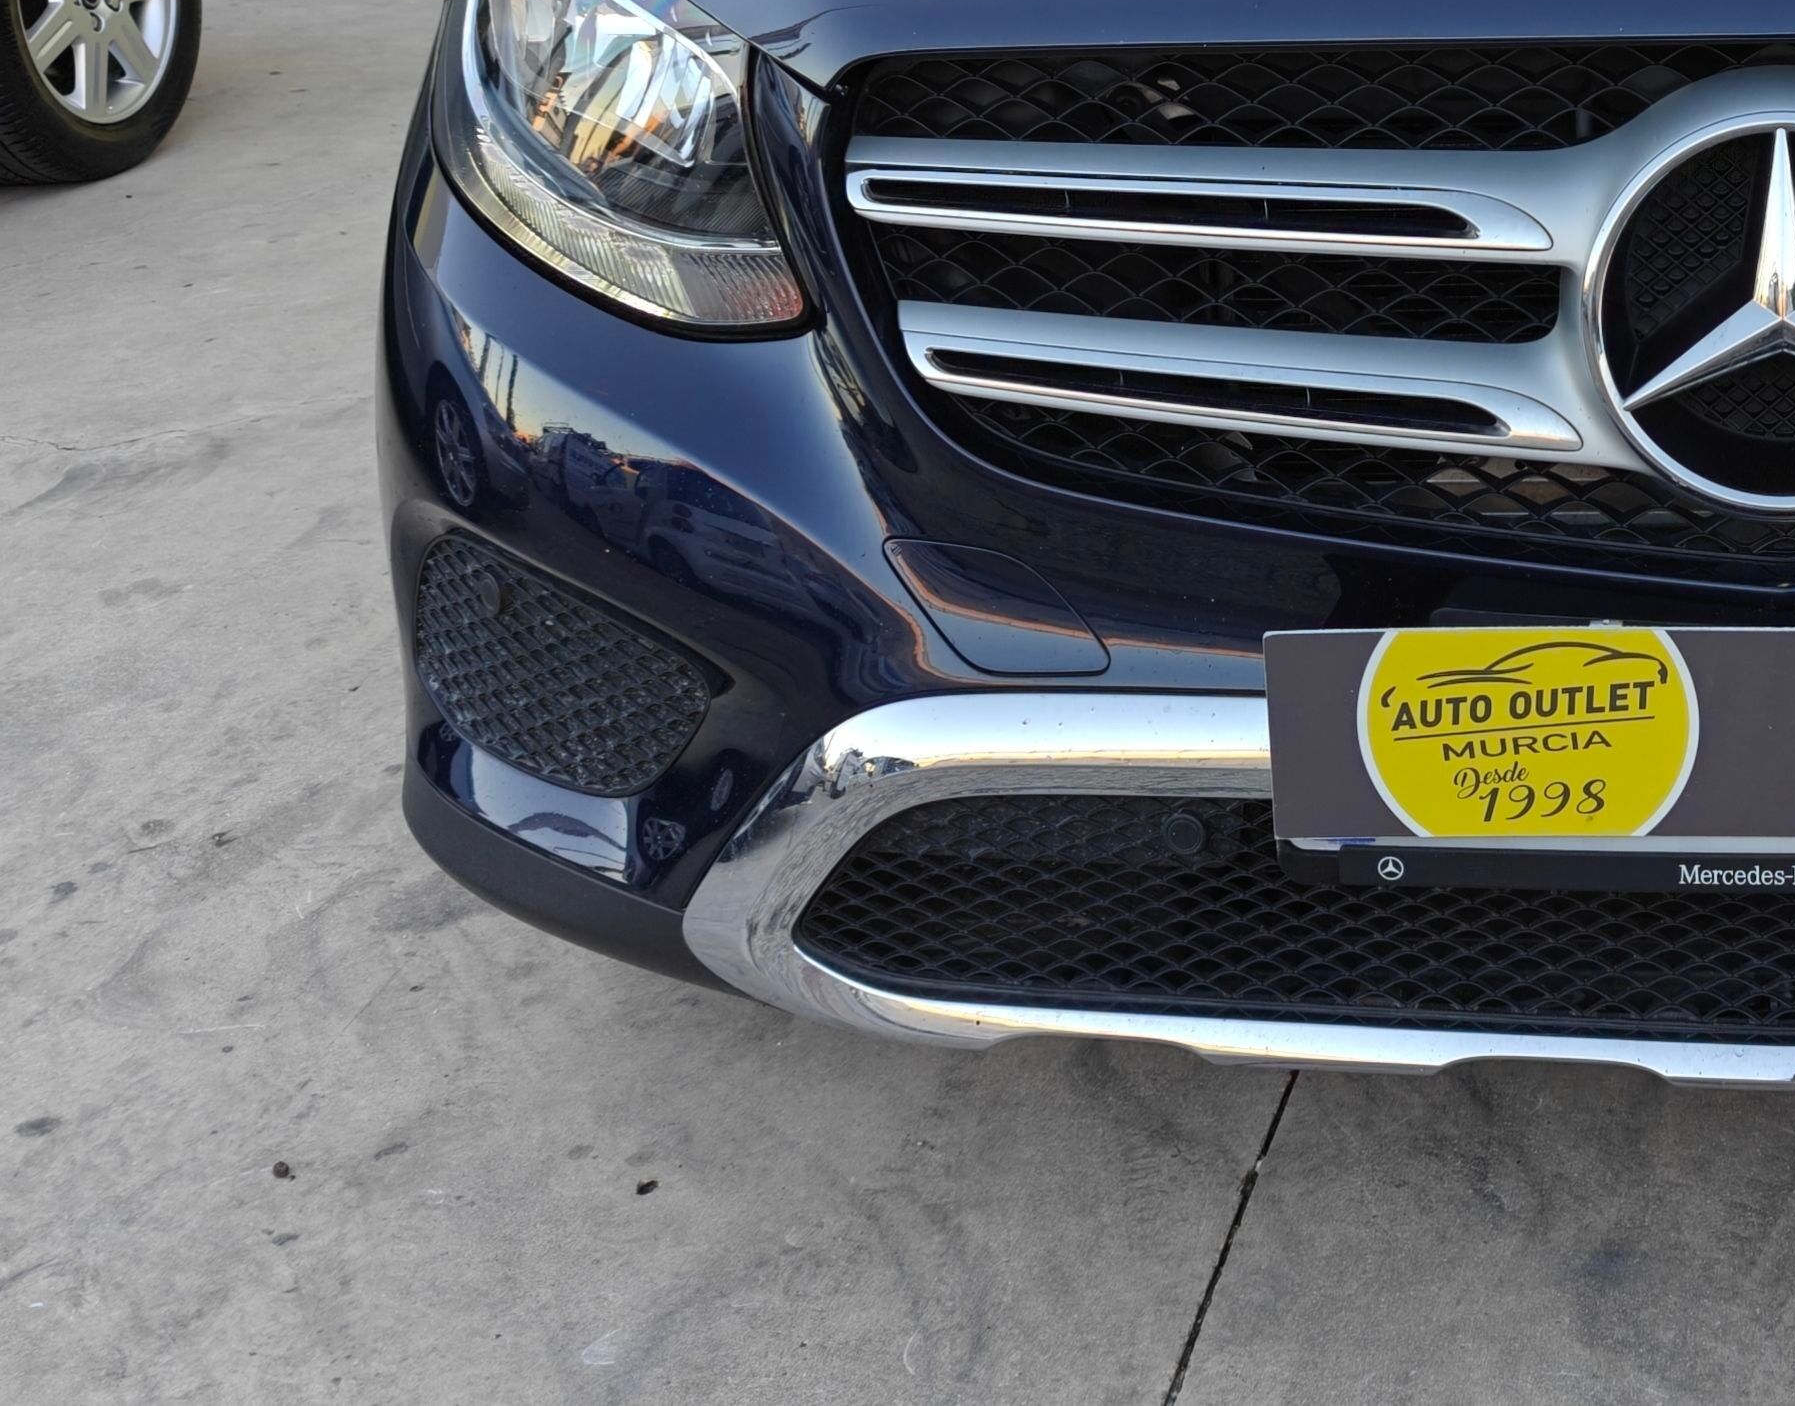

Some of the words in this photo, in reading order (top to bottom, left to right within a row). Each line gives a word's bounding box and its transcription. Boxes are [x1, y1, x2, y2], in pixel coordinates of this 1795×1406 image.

[1391, 694, 1493, 732] AUTO
[1508, 680, 1656, 721] OUTLET
[1442, 729, 1613, 762] MURCIA
[1453, 761, 1530, 800] Desde
[1478, 778, 1608, 823] 1998
